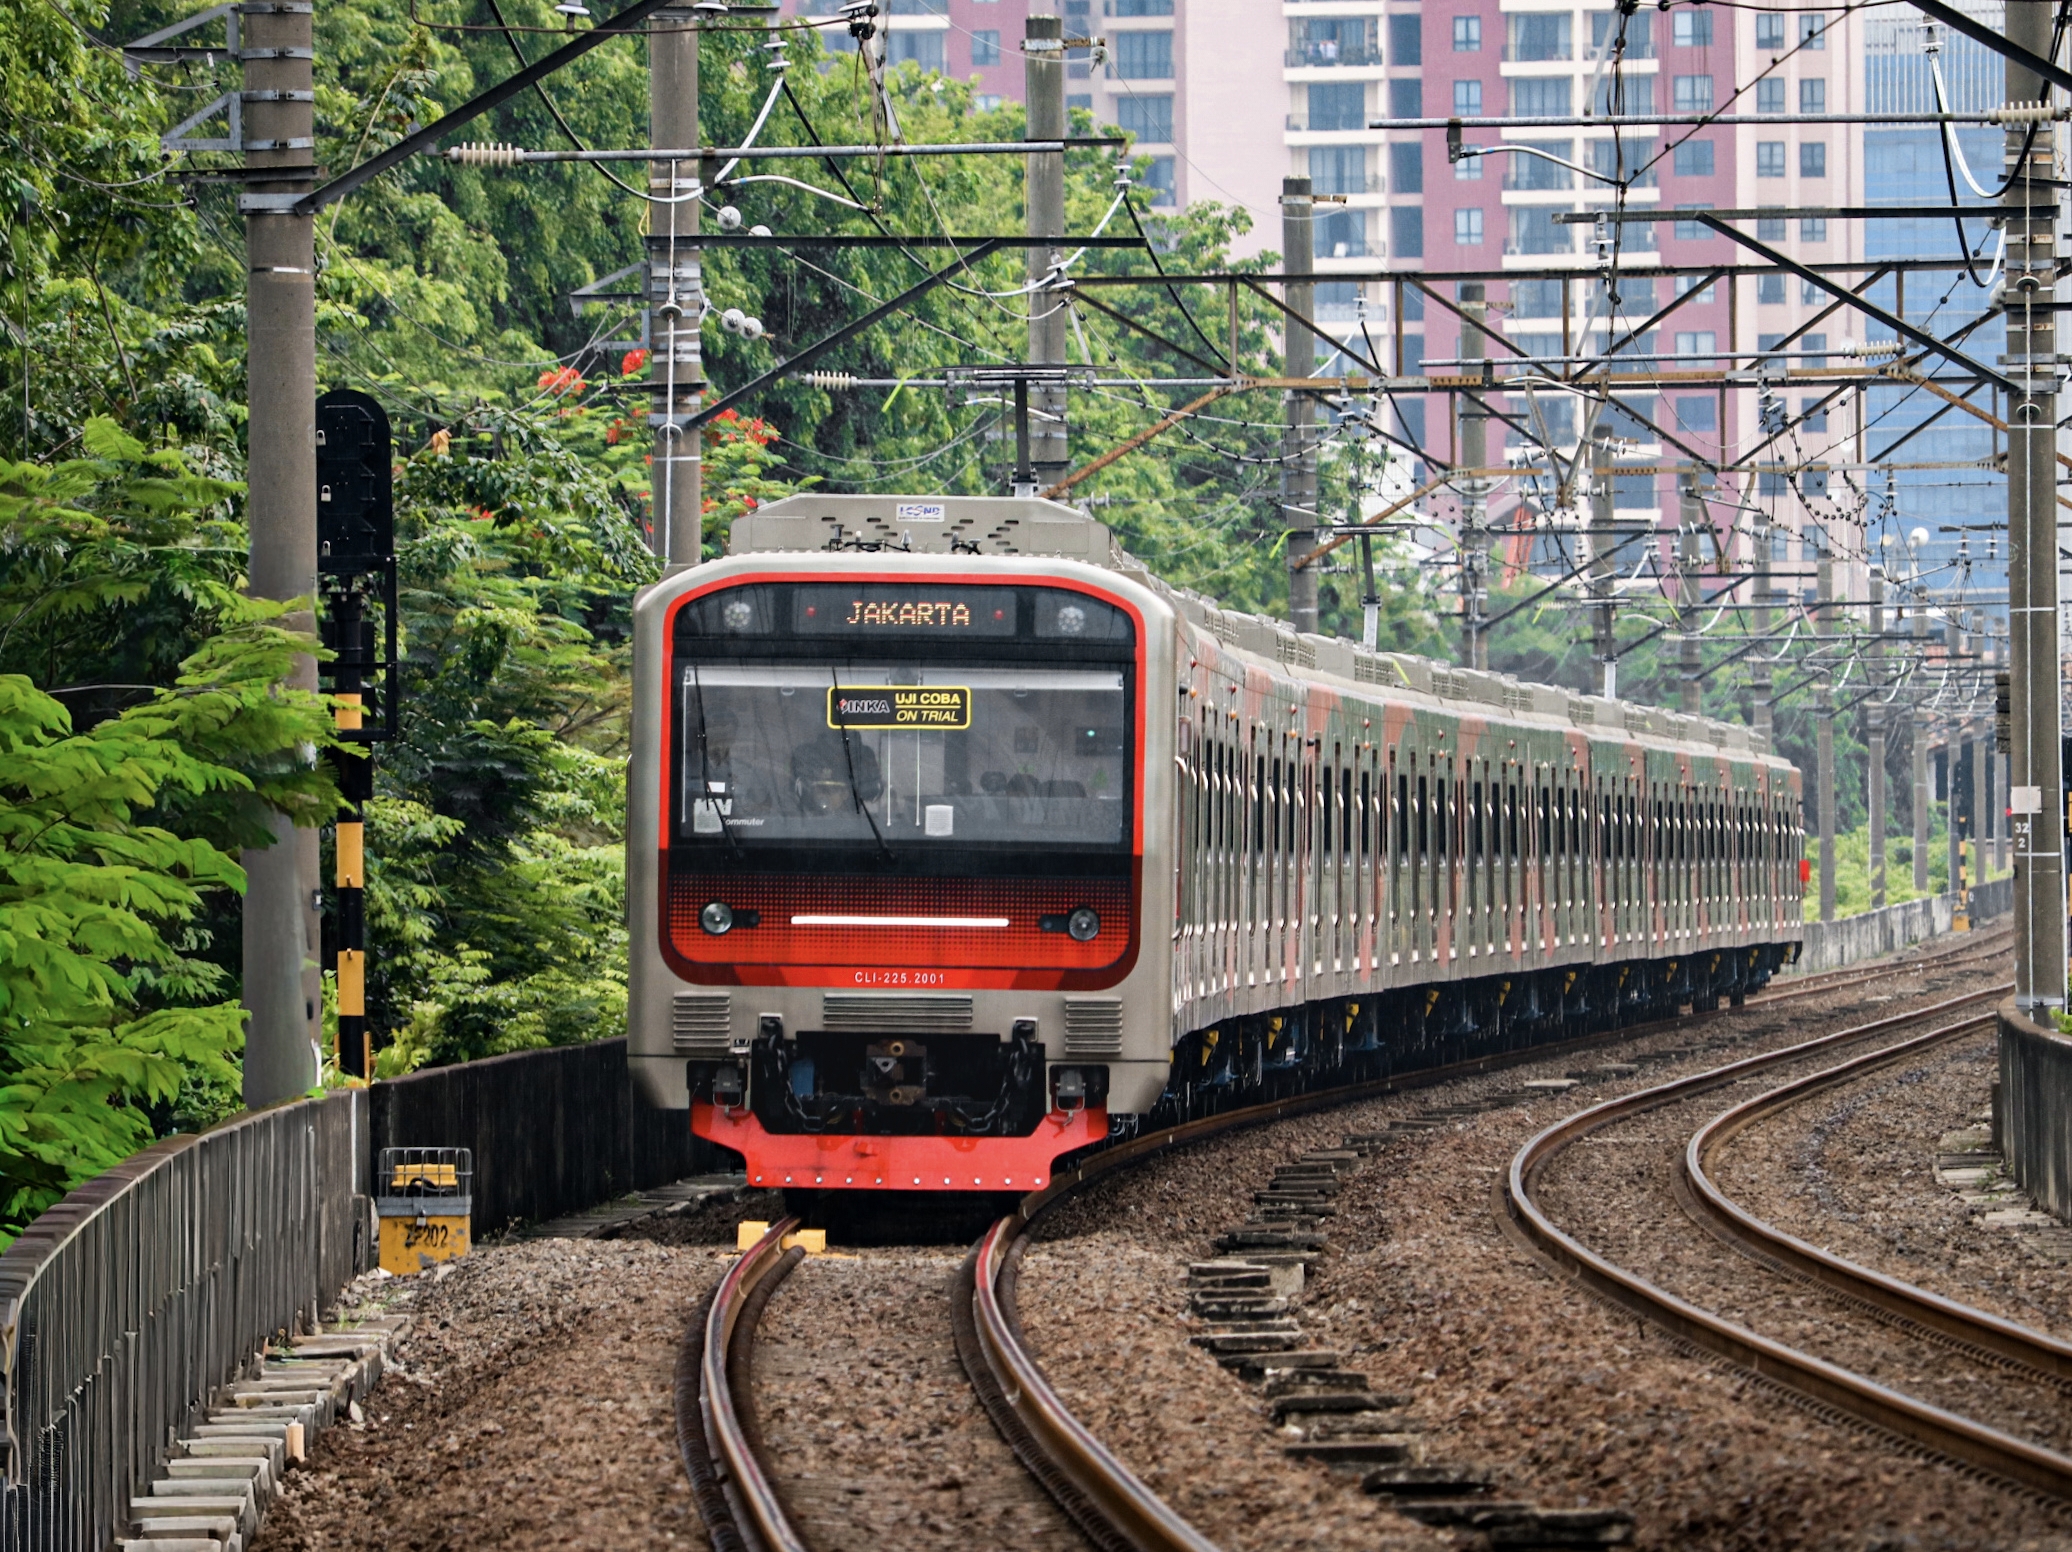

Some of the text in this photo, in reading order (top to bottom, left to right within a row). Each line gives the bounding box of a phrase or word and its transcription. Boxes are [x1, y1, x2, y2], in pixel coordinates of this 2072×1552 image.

[846, 600, 970, 626] JAKARTA
[895, 692, 961, 704] UJI COBA
[847, 699, 891, 713] INKA
[895, 710, 959, 722] ON TRIAL
[724, 817, 764, 826] ommuter
[2015, 822, 2030, 834] 32
[2018, 837, 2026, 848] 2
[854, 971, 944, 984] CLI-225.2001
